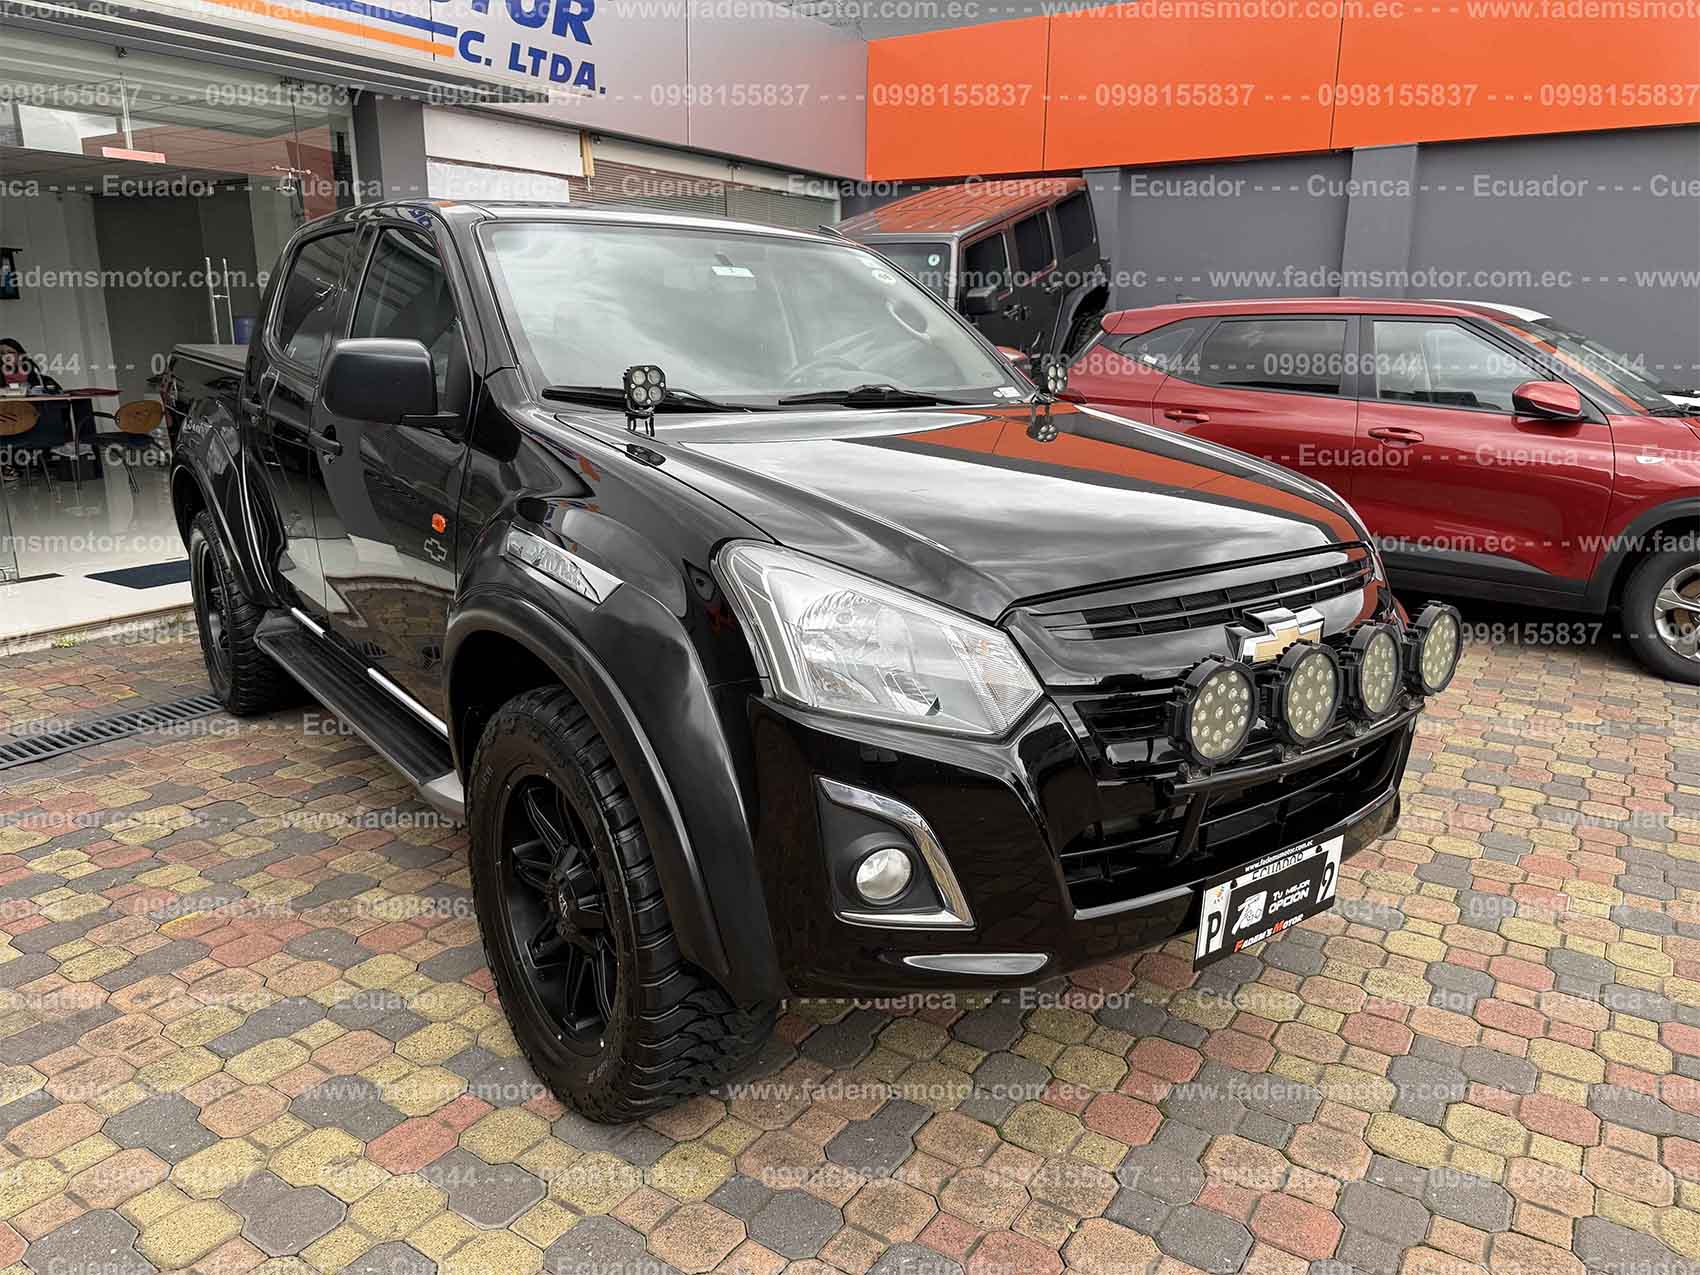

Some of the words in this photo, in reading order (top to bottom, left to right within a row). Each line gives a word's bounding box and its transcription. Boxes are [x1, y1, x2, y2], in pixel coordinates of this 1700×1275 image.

[472, 0, 596, 45] OR
[458, 30, 492, 67] C.
[508, 42, 606, 94] LTDA.
[1207, 910, 1222, 954] P
